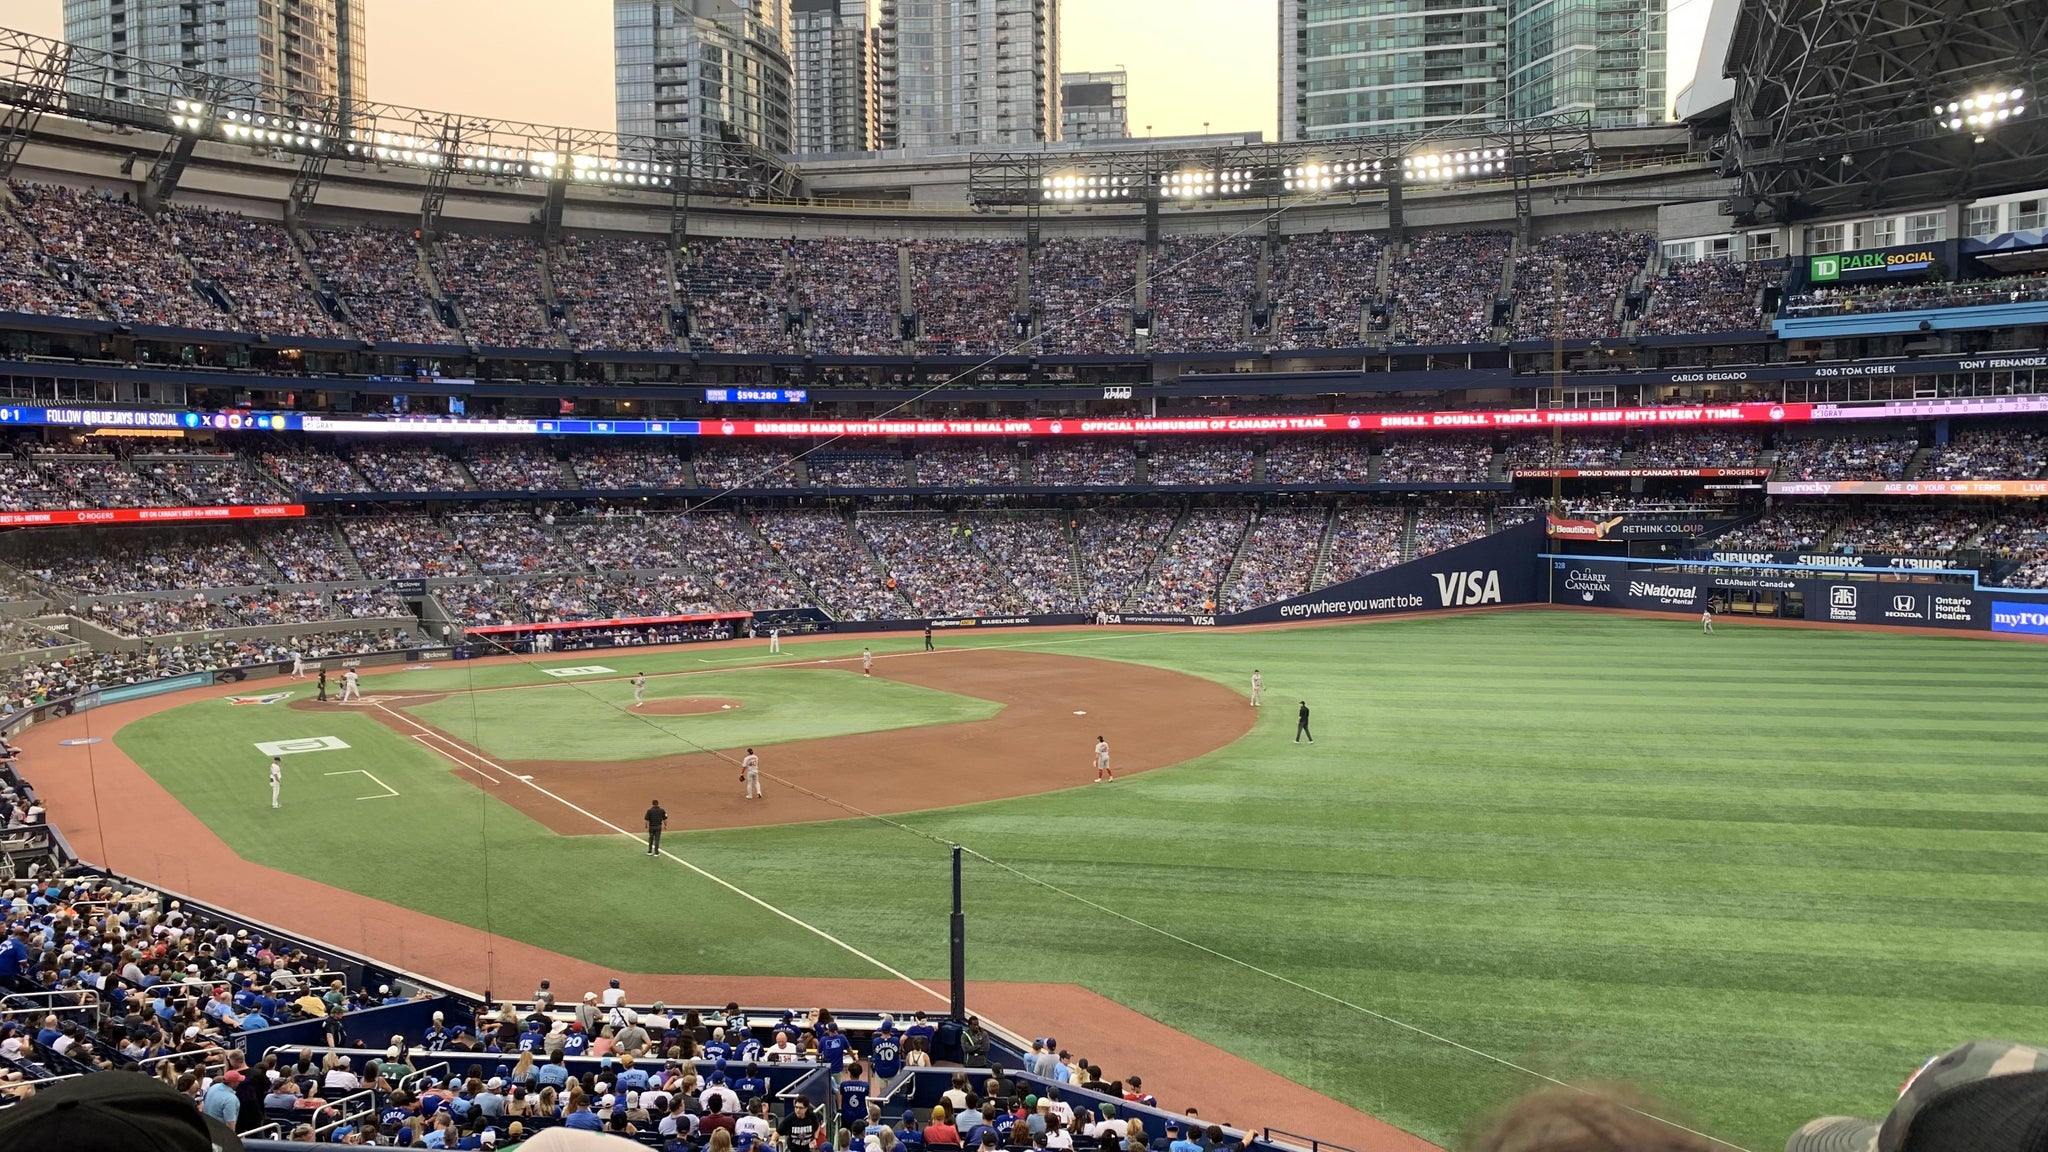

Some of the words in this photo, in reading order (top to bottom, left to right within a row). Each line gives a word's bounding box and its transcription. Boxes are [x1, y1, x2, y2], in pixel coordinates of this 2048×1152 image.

[1841, 252, 1886, 268] PARK
[1887, 252, 1935, 265] SOCIAL
[1959, 360, 1986, 370] TONY
[1990, 357, 2047, 368] FERNANDEZ
[1815, 368, 1838, 376] 4306
[1840, 367, 1863, 376] TOM
[1864, 365, 1896, 374] CHEEK
[1672, 374, 1704, 382] CARLOS
[1707, 372, 1746, 380] DELGADO
[1103, 390, 1131, 400] KPMG
[46, 410, 81, 423] FOLLOW
[83, 410, 133, 425] @BLUEJAYS
[136, 412, 147, 424] ON
[149, 412, 178, 425] SOCIAL
[1381, 416, 1429, 427] SINGLE.
[1434, 415, 1488, 425] DOUBLE.
[1494, 414, 1542, 424] TRIPLE.
[1548, 412, 1588, 422] FRESH
[1591, 411, 1622, 422] BEEF
[1625, 410, 1657, 421] HITS
[1660, 410, 1703, 420] EVERY
[1705, 408, 1744, 419] TIME.
[754, 424, 809, 433] BURGERS
[810, 424, 844, 432] MADE
[846, 424, 877, 432] WITH
[879, 423, 916, 432] FRESH
[917, 423, 947, 432] BEEF.
[949, 423, 971, 432] THE
[974, 423, 1002, 432] REAL
[1004, 423, 1032, 432] MVP.
[1081, 422, 1133, 431] OFFICIAL
[1135, 421, 1207, 430] HAMBURGER
[1210, 420, 1226, 429] OF
[1228, 419, 1287, 429] CANADA'S
[1289, 418, 1327, 428] TEAM.
[1782, 482, 1831, 493] myrocky
[1556, 525, 1595, 534] BeautiTone
[1622, 525, 1663, 534] RETHINK
[1664, 525, 1704, 533] COLOUR
[1798, 555, 1862, 568] SUBWAY
[1570, 570, 1606, 582] CLEARLY
[1432, 570, 1501, 606] VISA
[1565, 579, 1610, 592] CANADIAN
[1760, 580, 1788, 589] Canada
[1280, 601, 1347, 617] everywhere
[1348, 599, 1368, 614] you
[1369, 597, 1396, 609] want
[1397, 597, 1408, 608] to
[1409, 594, 1423, 606] be
[1936, 597, 1971, 606] Ontario
[1830, 608, 1856, 616] Home
[1936, 604, 1966, 613] Honda
[1190, 616, 1215, 625] VISA
[1936, 612, 1971, 621] Dealers
[1995, 613, 2048, 626] myro
[520, 1040, 533, 1051] 15
[565, 1036, 582, 1048] 20
[880, 1049, 894, 1060] 10
[850, 1095, 859, 1107] 6
